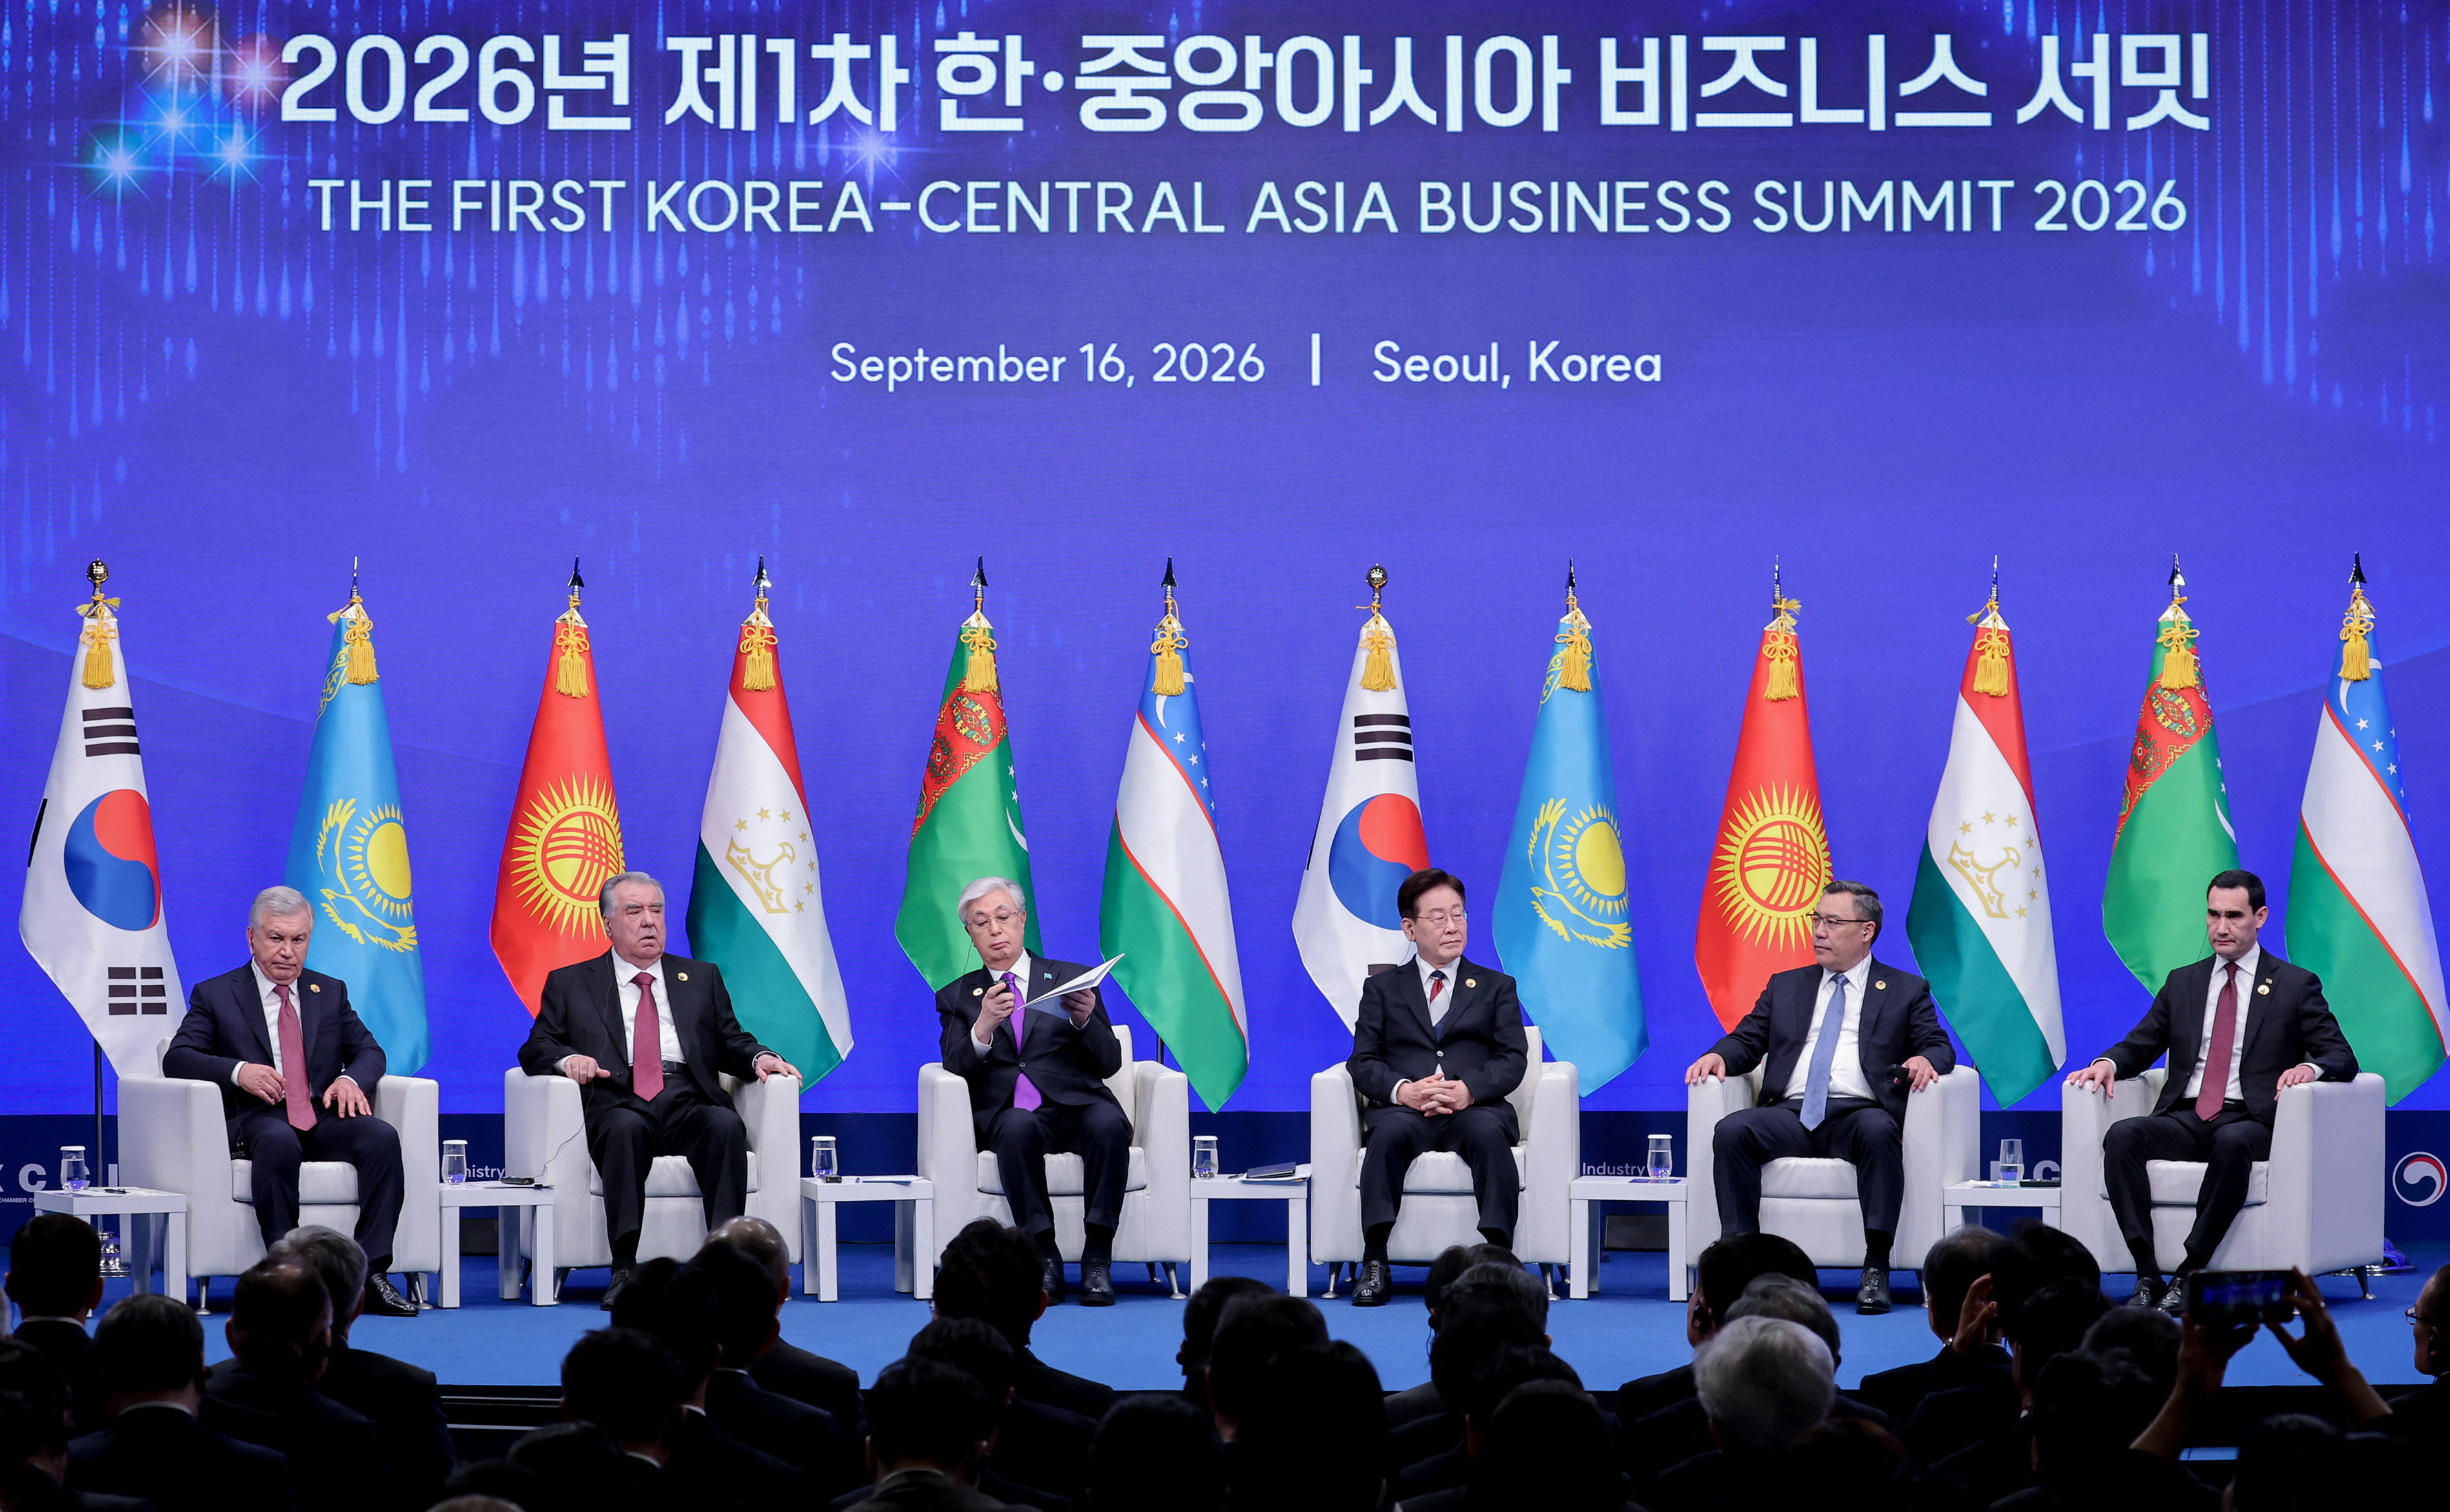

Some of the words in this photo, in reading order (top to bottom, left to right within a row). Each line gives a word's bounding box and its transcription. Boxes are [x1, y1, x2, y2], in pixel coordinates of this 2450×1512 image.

[281, 34, 631, 130] 2026년
[665, 33, 909, 132] 제1차
[1600, 34, 1992, 131] 비즈니스
[2016, 33, 2210, 131] 서밋
[308, 179, 433, 232] THE
[453, 179, 626, 232] FIRST
[1245, 181, 1399, 233] ASIA
[1420, 181, 1731, 233] BUSINESS
[1753, 180, 2014, 232] SUMMIT
[2034, 179, 2187, 231] 2026
[831, 342, 1067, 392] September
[1079, 343, 1135, 389] 16,
[1152, 342, 1265, 383] 2026
[1373, 340, 1511, 389] Seoul,
[1529, 340, 1662, 383] Korea
[466, 1164, 505, 1181] nistry
[1582, 1162, 1646, 1177] Industry
